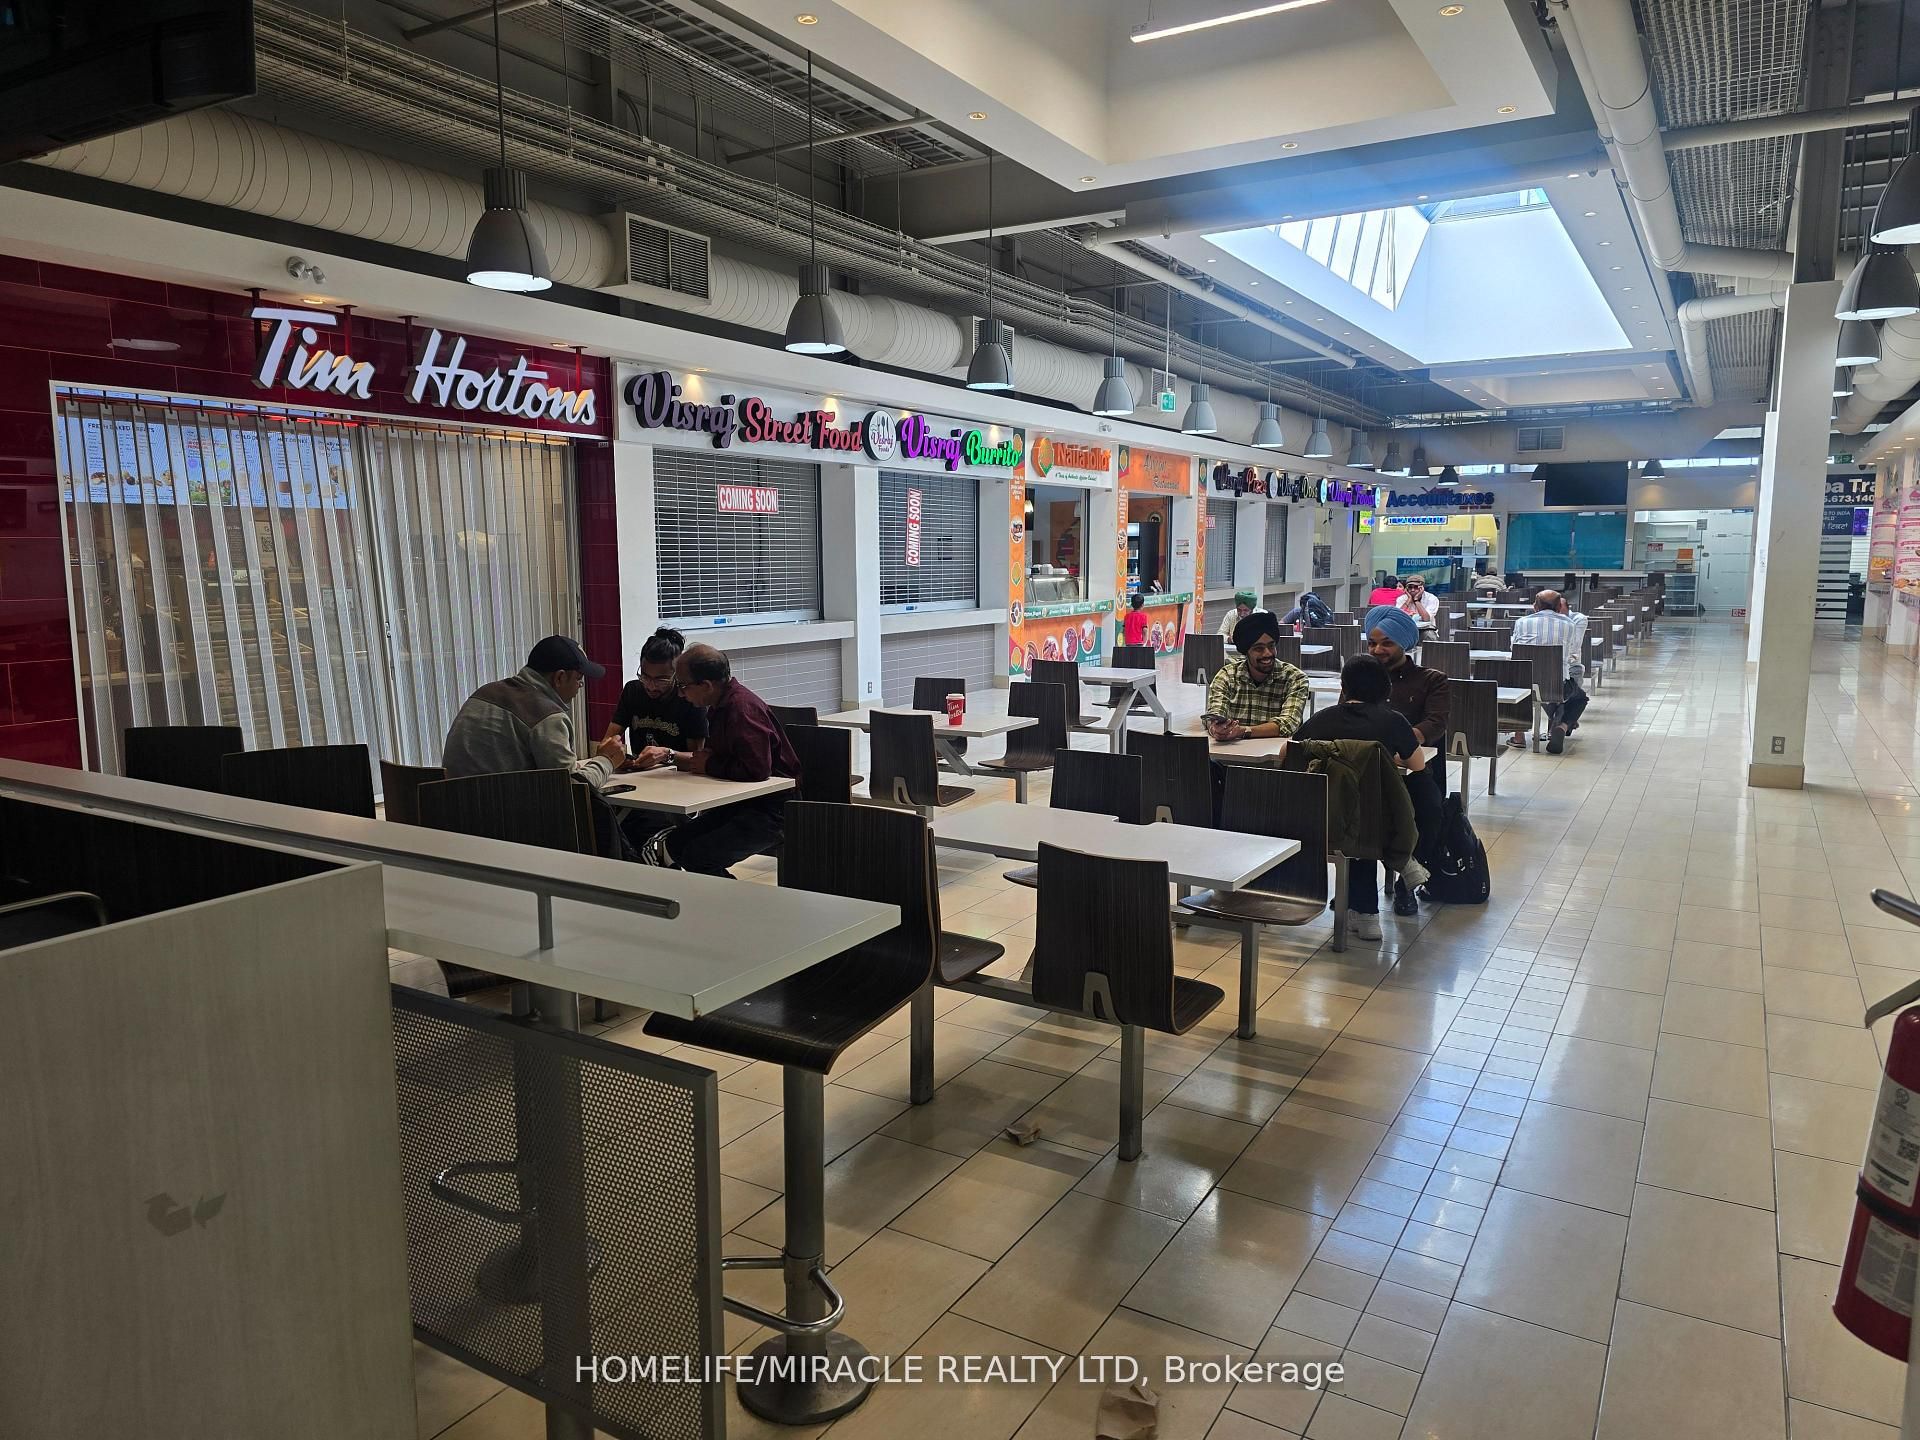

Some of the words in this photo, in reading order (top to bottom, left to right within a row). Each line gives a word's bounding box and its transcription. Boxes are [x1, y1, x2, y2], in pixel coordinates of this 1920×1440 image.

[251, 307, 375, 399] Tim
[408, 328, 596, 426] Hortons
[626, 371, 737, 448] Visraj
[739, 397, 813, 443] Street
[813, 410, 864, 451] Food
[871, 431, 893, 448] Visraj
[897, 415, 962, 472] Visraj
[964, 429, 1021, 467] Burrito
[1243, 467, 1267, 495] Pizza
[720, 487, 753, 510] COMING
[755, 489, 777, 511] SOON
[910, 490, 921, 521] SOON
[1386, 490, 1495, 507] Accountaxes
[907, 522, 919, 565] COMING
[1403, 558, 1445, 566] ACCOUNTAXES
